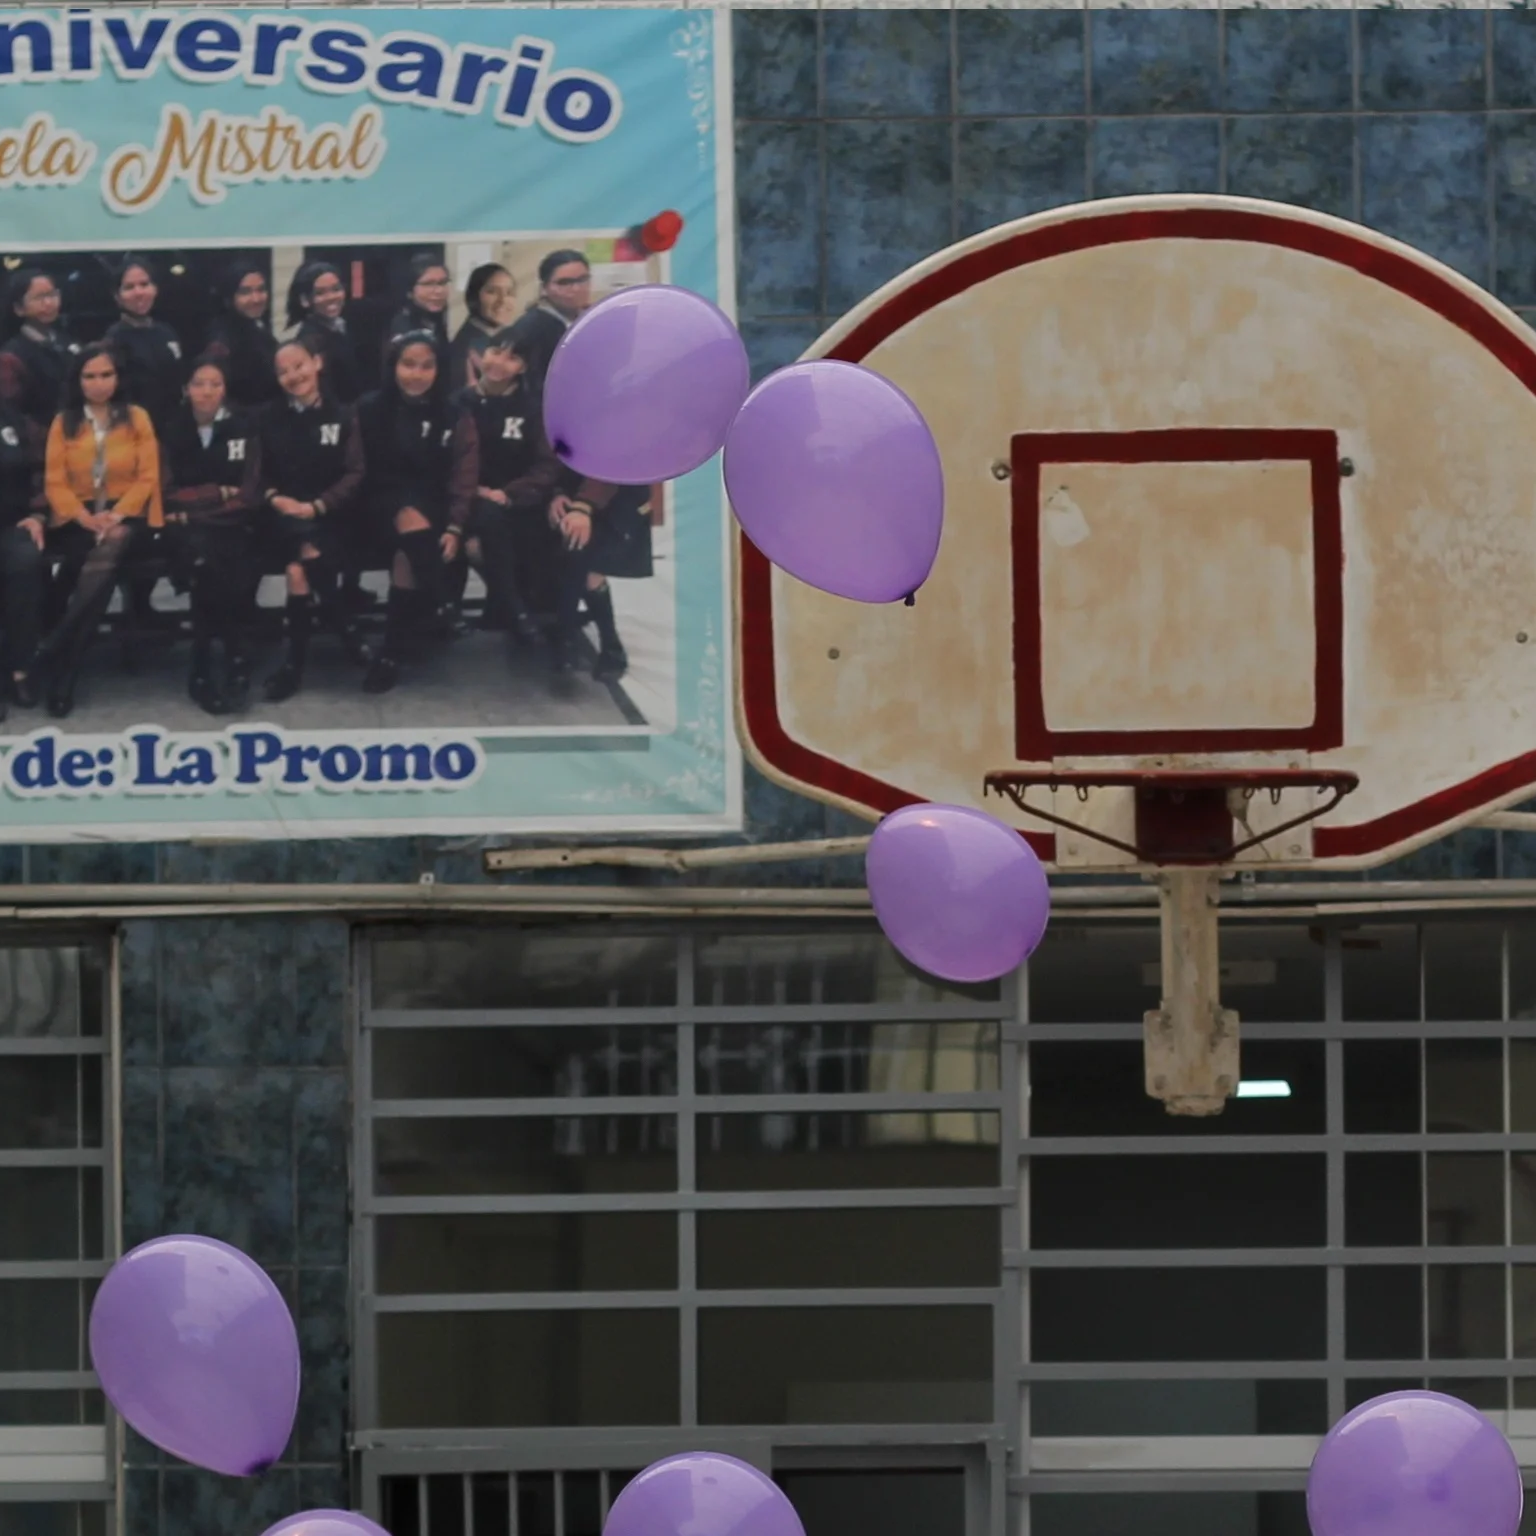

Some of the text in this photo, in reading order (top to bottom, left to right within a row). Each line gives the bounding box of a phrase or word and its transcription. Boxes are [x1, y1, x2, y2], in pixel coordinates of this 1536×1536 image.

[111, 111, 376, 205] Mistral
[12, 738, 114, 788] de:
[131, 734, 215, 786] La
[233, 733, 478, 785] Promo
